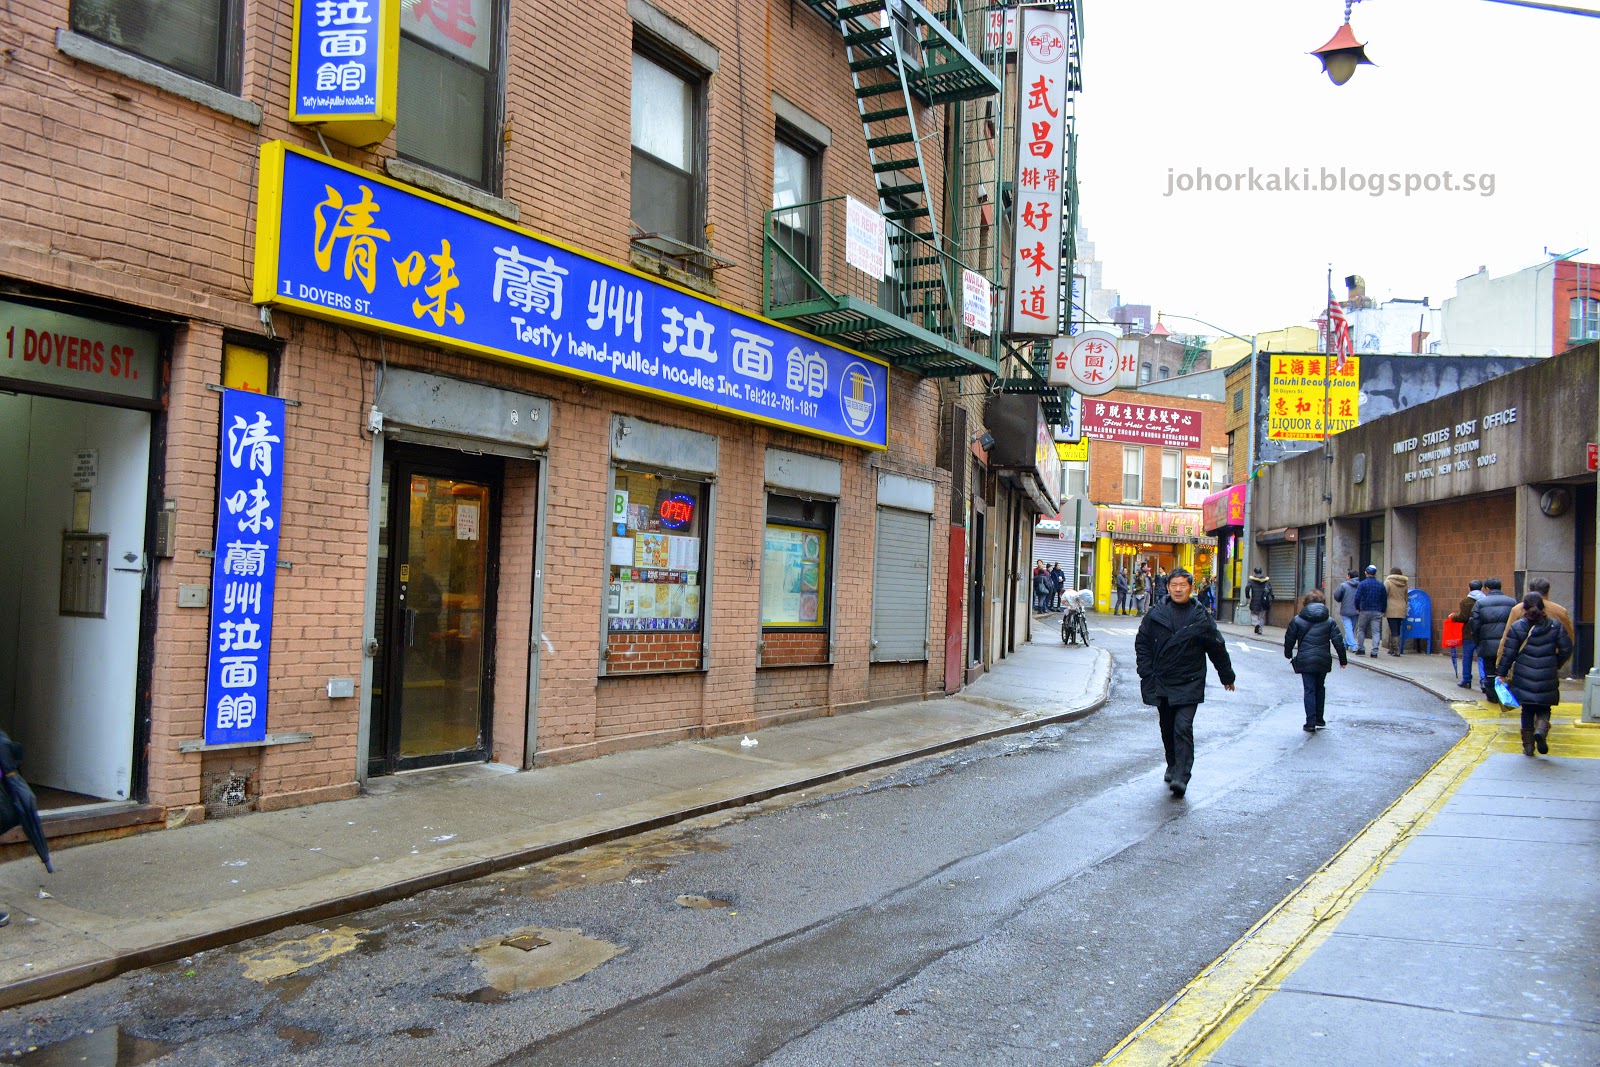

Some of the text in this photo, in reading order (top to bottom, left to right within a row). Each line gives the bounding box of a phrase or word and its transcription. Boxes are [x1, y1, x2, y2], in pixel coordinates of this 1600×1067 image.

[862, 216, 878, 236] RENT
[283, 280, 373, 315] 1 DOYERS ST.
[7, 326, 138, 380] 1 DOYERS ST.
[511, 316, 563, 357] Tasty
[568, 332, 659, 377] hand-pulled
[662, 363, 715, 392] noodles
[717, 375, 743, 399] Inc.
[1333, 378, 1356, 388] Salon
[1162, 425, 1180, 433] Spa
[1272, 418, 1311, 431] LIQUOR
[1315, 419, 1322, 430] &
[1393, 407, 1517, 455] UNITED STATES POST OFFICE
[1418, 439, 1480, 464] CHINATOWN STATION
[1405, 471, 1417, 482] NEW
[1438, 463, 1452, 476] NEW
[1477, 453, 1497, 467] 10013
[614, 494, 624, 514] B
[661, 500, 693, 522] OPEN
